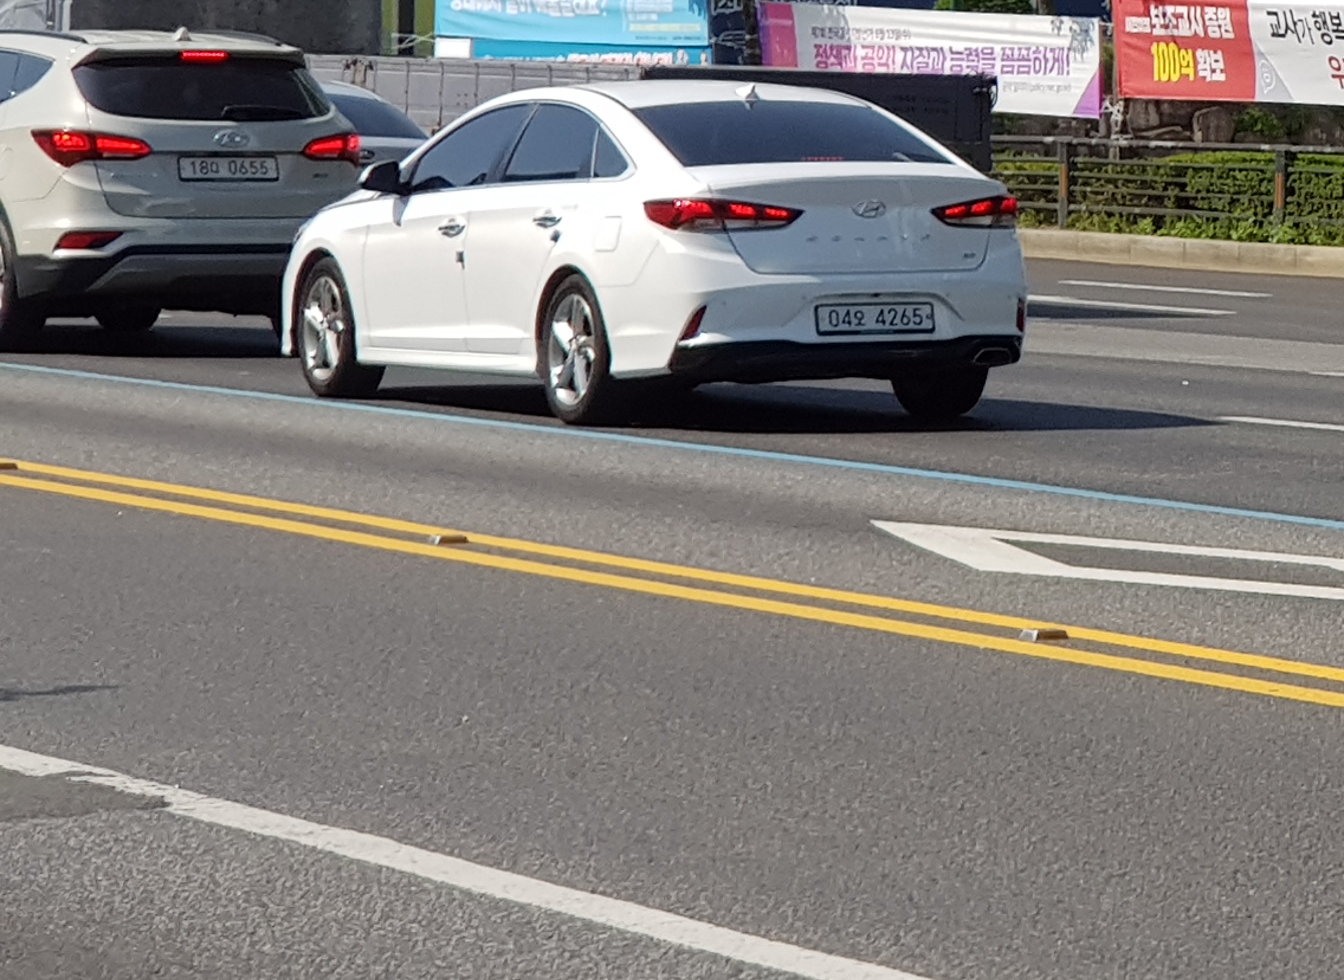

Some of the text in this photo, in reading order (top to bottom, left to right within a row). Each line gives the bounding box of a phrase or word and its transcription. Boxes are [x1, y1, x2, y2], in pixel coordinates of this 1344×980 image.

[1150, 3, 1205, 39] 보조교사
[1204, 5, 1236, 40] 증원
[1265, 8, 1313, 45] 교사가
[813, 43, 858, 72] 정책과
[860, 44, 896, 73] 공약!
[899, 45, 947, 75] 자질과
[1000, 46, 1072, 77] 꼼꼼하게!
[1150, 41, 1227, 83] 100억 확보
[228, 160, 269, 176] 0655
[828, 307, 924, 328] 04오 4265
